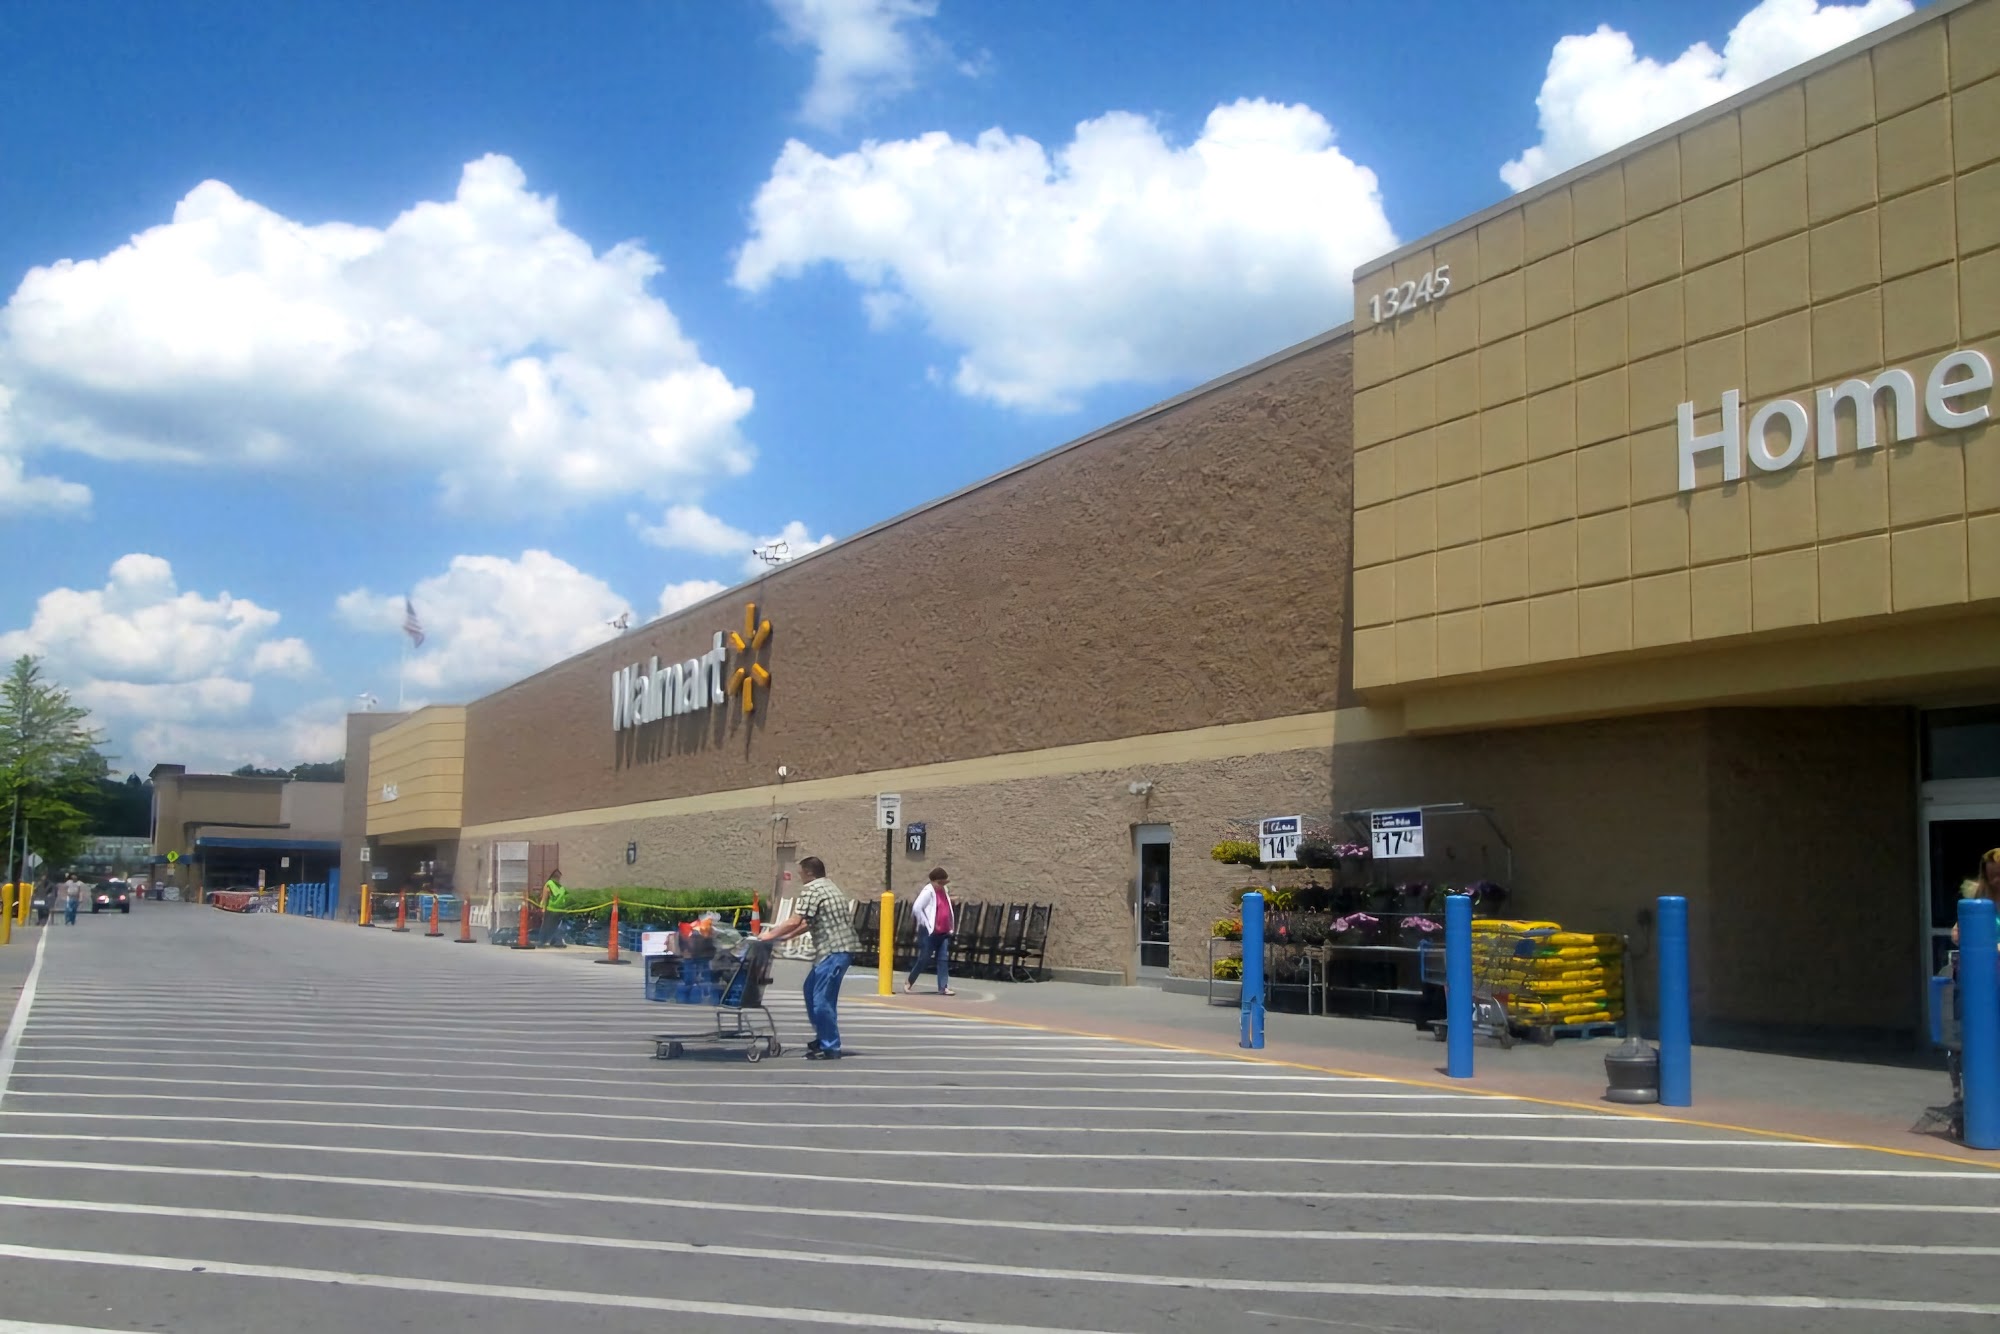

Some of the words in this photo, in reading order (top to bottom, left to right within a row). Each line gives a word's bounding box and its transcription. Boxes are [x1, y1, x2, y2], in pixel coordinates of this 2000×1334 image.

[1369, 264, 1450, 324] 13245
[1677, 349, 1993, 492] Home
[612, 630, 726, 732] Walmart
[886, 810, 895, 825] 5
